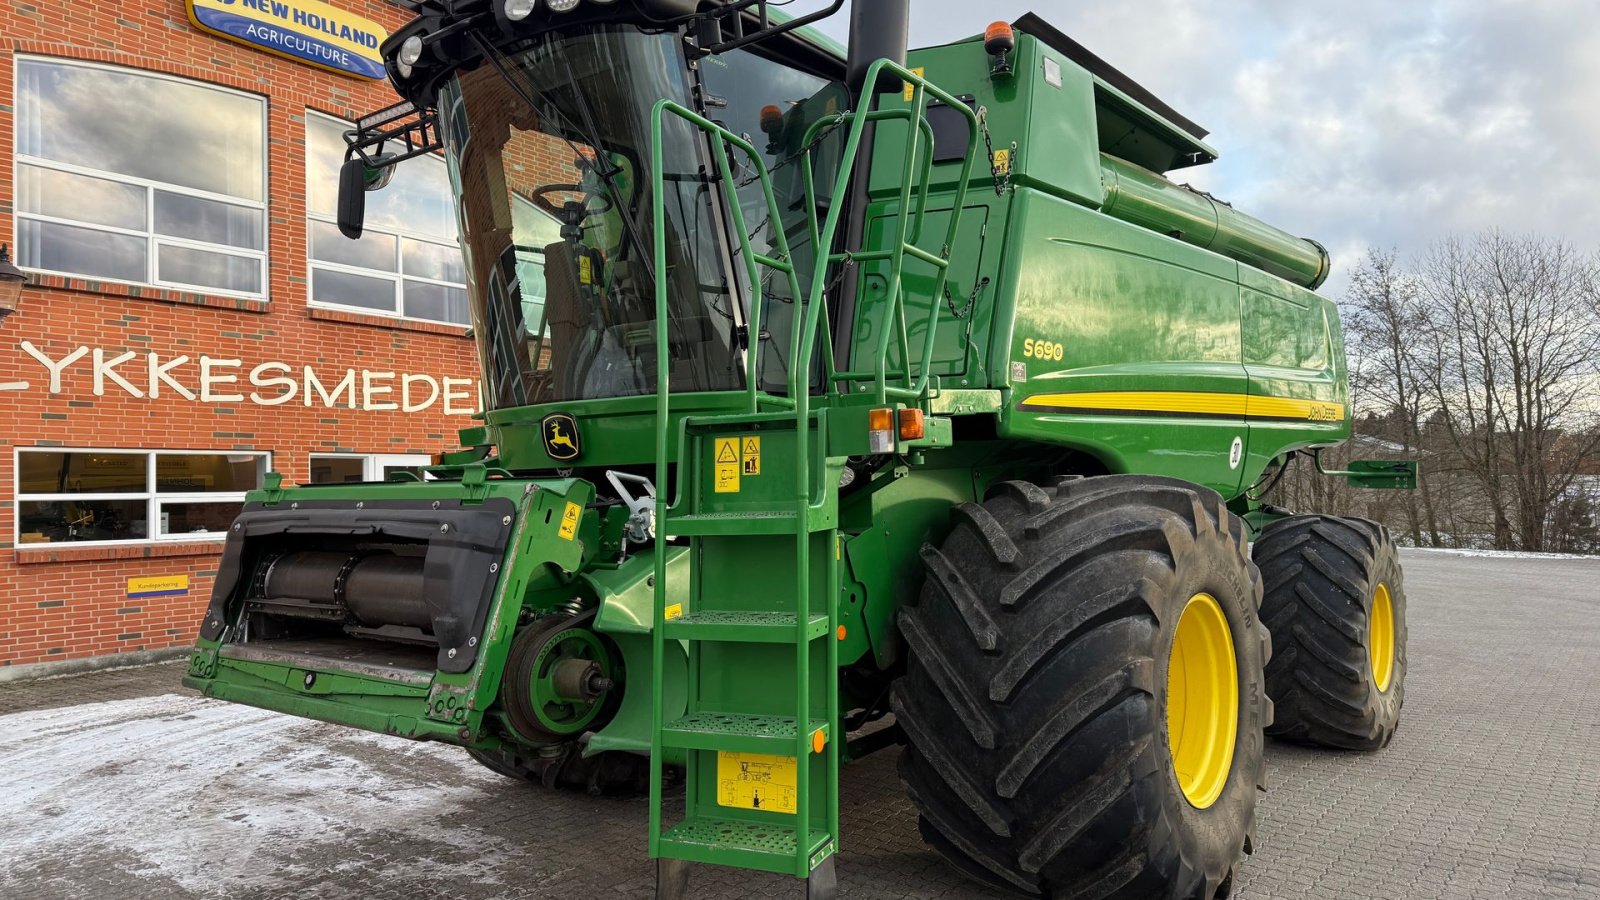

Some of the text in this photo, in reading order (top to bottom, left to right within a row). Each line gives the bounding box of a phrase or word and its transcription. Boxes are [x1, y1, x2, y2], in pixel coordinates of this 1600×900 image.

[242, 0, 378, 50] NEW HOLLAND
[246, 23, 350, 66] AGRICULTURE
[1023, 338, 1064, 361] S690
[0, 340, 484, 415] YKKESMEDE
